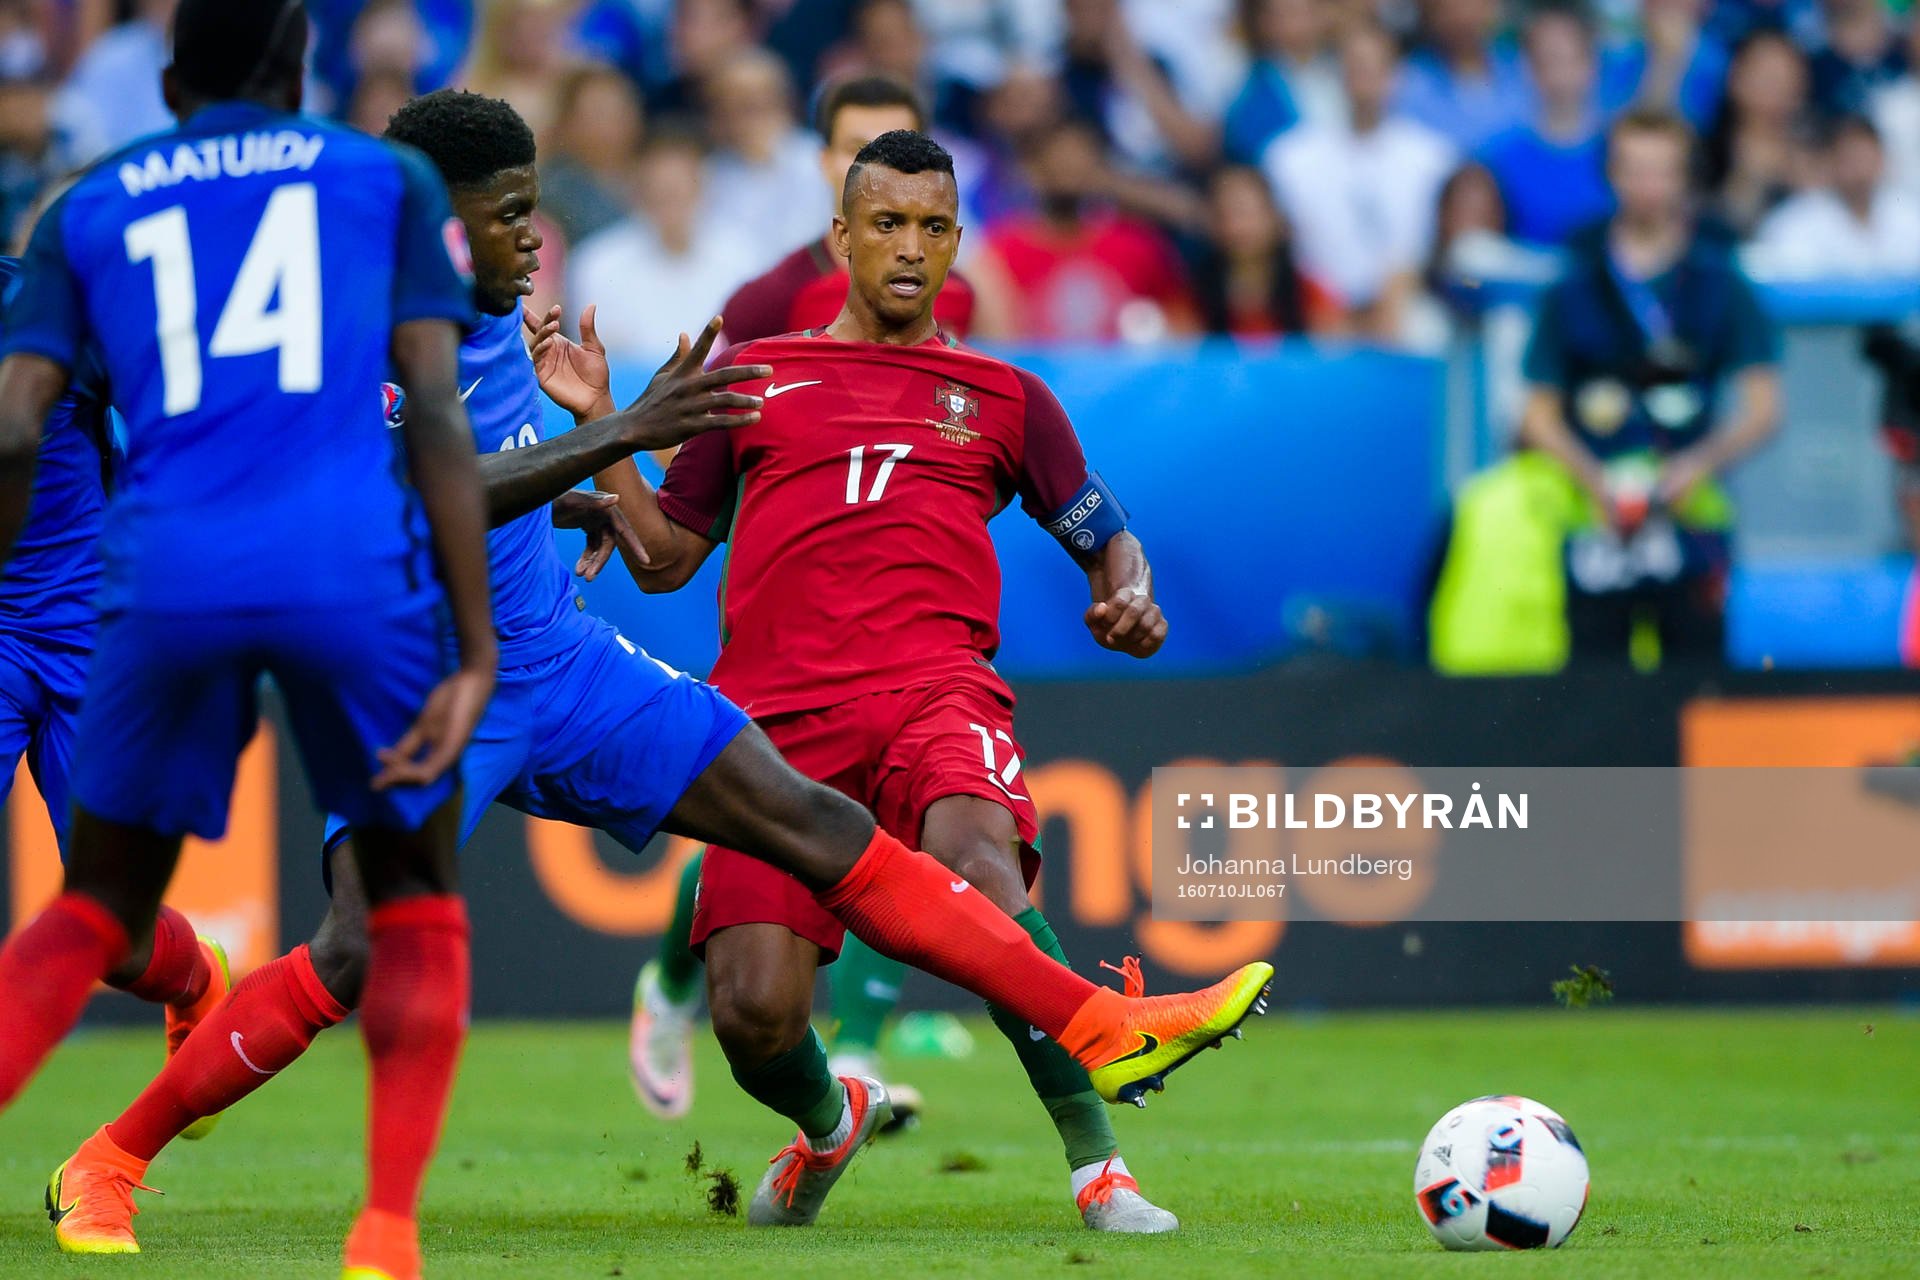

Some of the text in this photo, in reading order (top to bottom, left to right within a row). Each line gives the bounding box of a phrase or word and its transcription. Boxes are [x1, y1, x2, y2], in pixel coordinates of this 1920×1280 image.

[118, 130, 325, 197] MATUIDI
[124, 181, 323, 418] 14
[845, 443, 914, 505] 17
[1086, 491, 1101, 508] NO
[1072, 506, 1089, 521] TO
[968, 722, 1021, 786] 17
